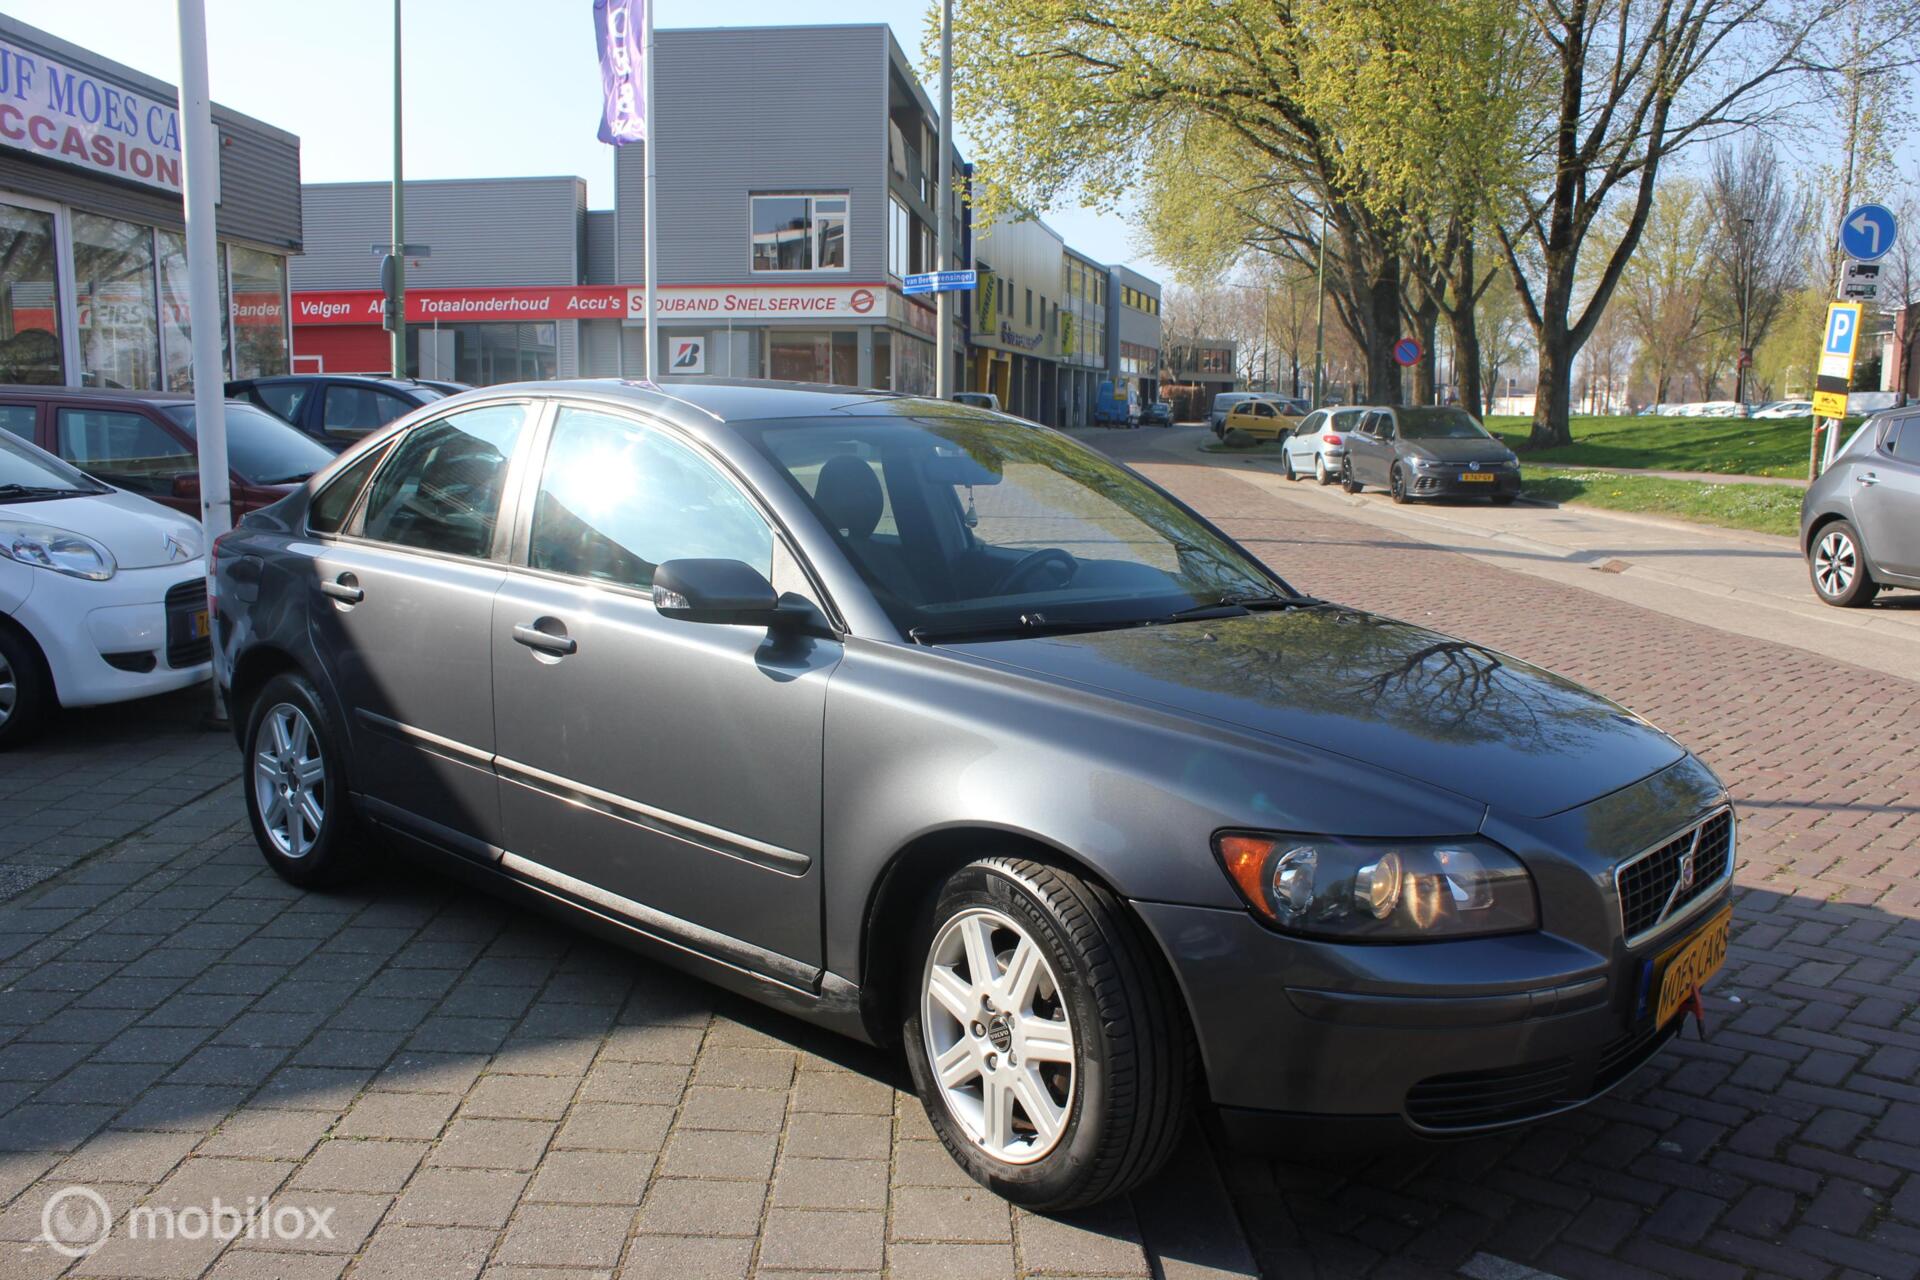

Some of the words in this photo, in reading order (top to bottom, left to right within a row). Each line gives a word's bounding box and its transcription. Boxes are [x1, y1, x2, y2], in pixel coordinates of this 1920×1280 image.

[47, 65, 139, 138] MOES
[146, 105, 181, 153] CA
[0, 103, 180, 187] CCASION
[301, 301, 350, 318] Velgen
[419, 296, 550, 313] Totaalonderhoud
[567, 296, 621, 310] Accu's
[630, 295, 719, 312] SOUBAND
[723, 294, 837, 312] SNELSERVICE
[1830, 313, 1850, 349] P
[1012, 893, 1074, 974] MICHELIN
[1661, 950, 1697, 1012] MOES
[1697, 920, 1730, 979] CARS
[989, 1029, 1009, 1040] VOLVO
